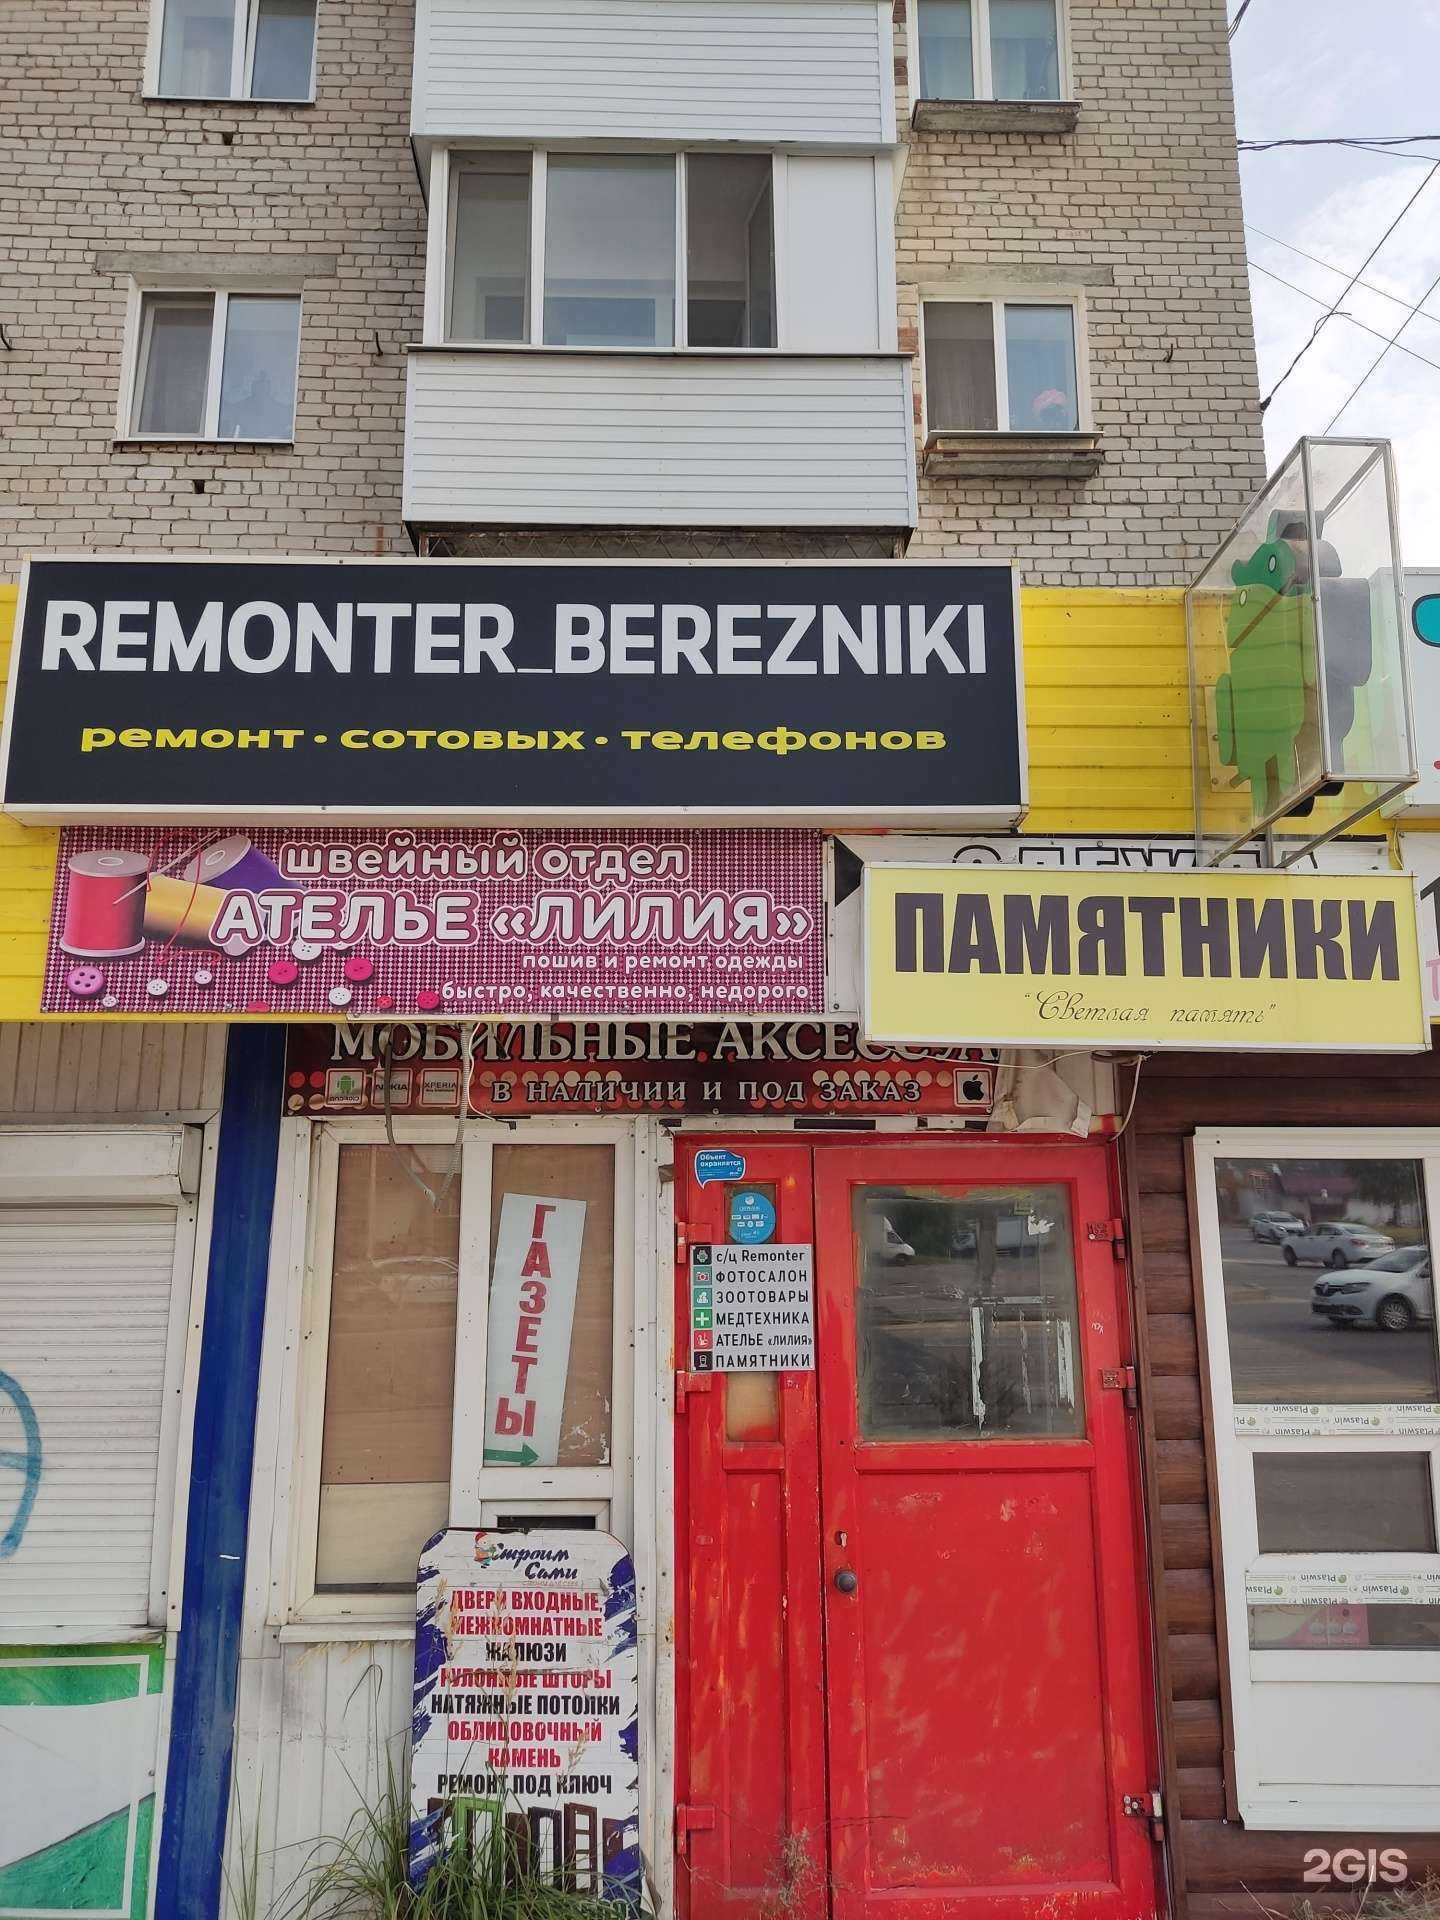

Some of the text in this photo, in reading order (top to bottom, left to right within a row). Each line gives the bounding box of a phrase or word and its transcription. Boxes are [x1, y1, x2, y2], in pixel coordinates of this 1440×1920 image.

[41, 600, 987, 676] REMONTER_BEREZNIKI
[81, 726, 947, 756] ремонт сотовых телефонов
[284, 832, 686, 881] швейный отдел
[215, 893, 809, 943] АТЕЛЬЕ «ЛИЛИЯ»
[894, 892, 1400, 981] ПАМЯТНИКИ
[522, 954, 803, 974] пошив и ремонт одежды
[441, 981, 809, 1002] быстро, качественно, недорого
[526, 1081, 688, 1103] НАЛИЧИИ
[702, 1081, 723, 1103] И
[737, 1081, 806, 1104] ПОД
[818, 1080, 922, 1103] ЗАКАЗ
[700, 1153, 726, 1161] Объект
[700, 1160, 741, 1168] охраняется
[716, 1248, 805, 1265] с/ц Remonter
[715, 1269, 808, 1283] ФОТОСАЛОН
[715, 1290, 809, 1304] ЗООТОВАРЫ
[494, 1203, 557, 1437] ГАЗЕТЫ
[715, 1311, 810, 1328] МЕДТЕХНИКА
[715, 1333, 813, 1347] АТЕЛЬЕ «ЛИЛИЯ»
[715, 1354, 811, 1368] ПАМЯТНИКИ
[1334, 1416, 1370, 1425] Plaswin
[524, 1561, 578, 1581] Сами
[1300, 1573, 1337, 1583] Plaswin
[1362, 1585, 1399, 1595] Plaswin
[450, 1590, 507, 1612] ДВЕРИ
[431, 1695, 620, 1715] НАТЯЖНЫЕ ПОТОЛКИ
[447, 1718, 603, 1742] ОБЛИЦОВОЧНЫЙ
[488, 1748, 562, 1768] КАМЕНЬ
[437, 1774, 613, 1797] РЕМОНТ ПОД КЛЮЧ
